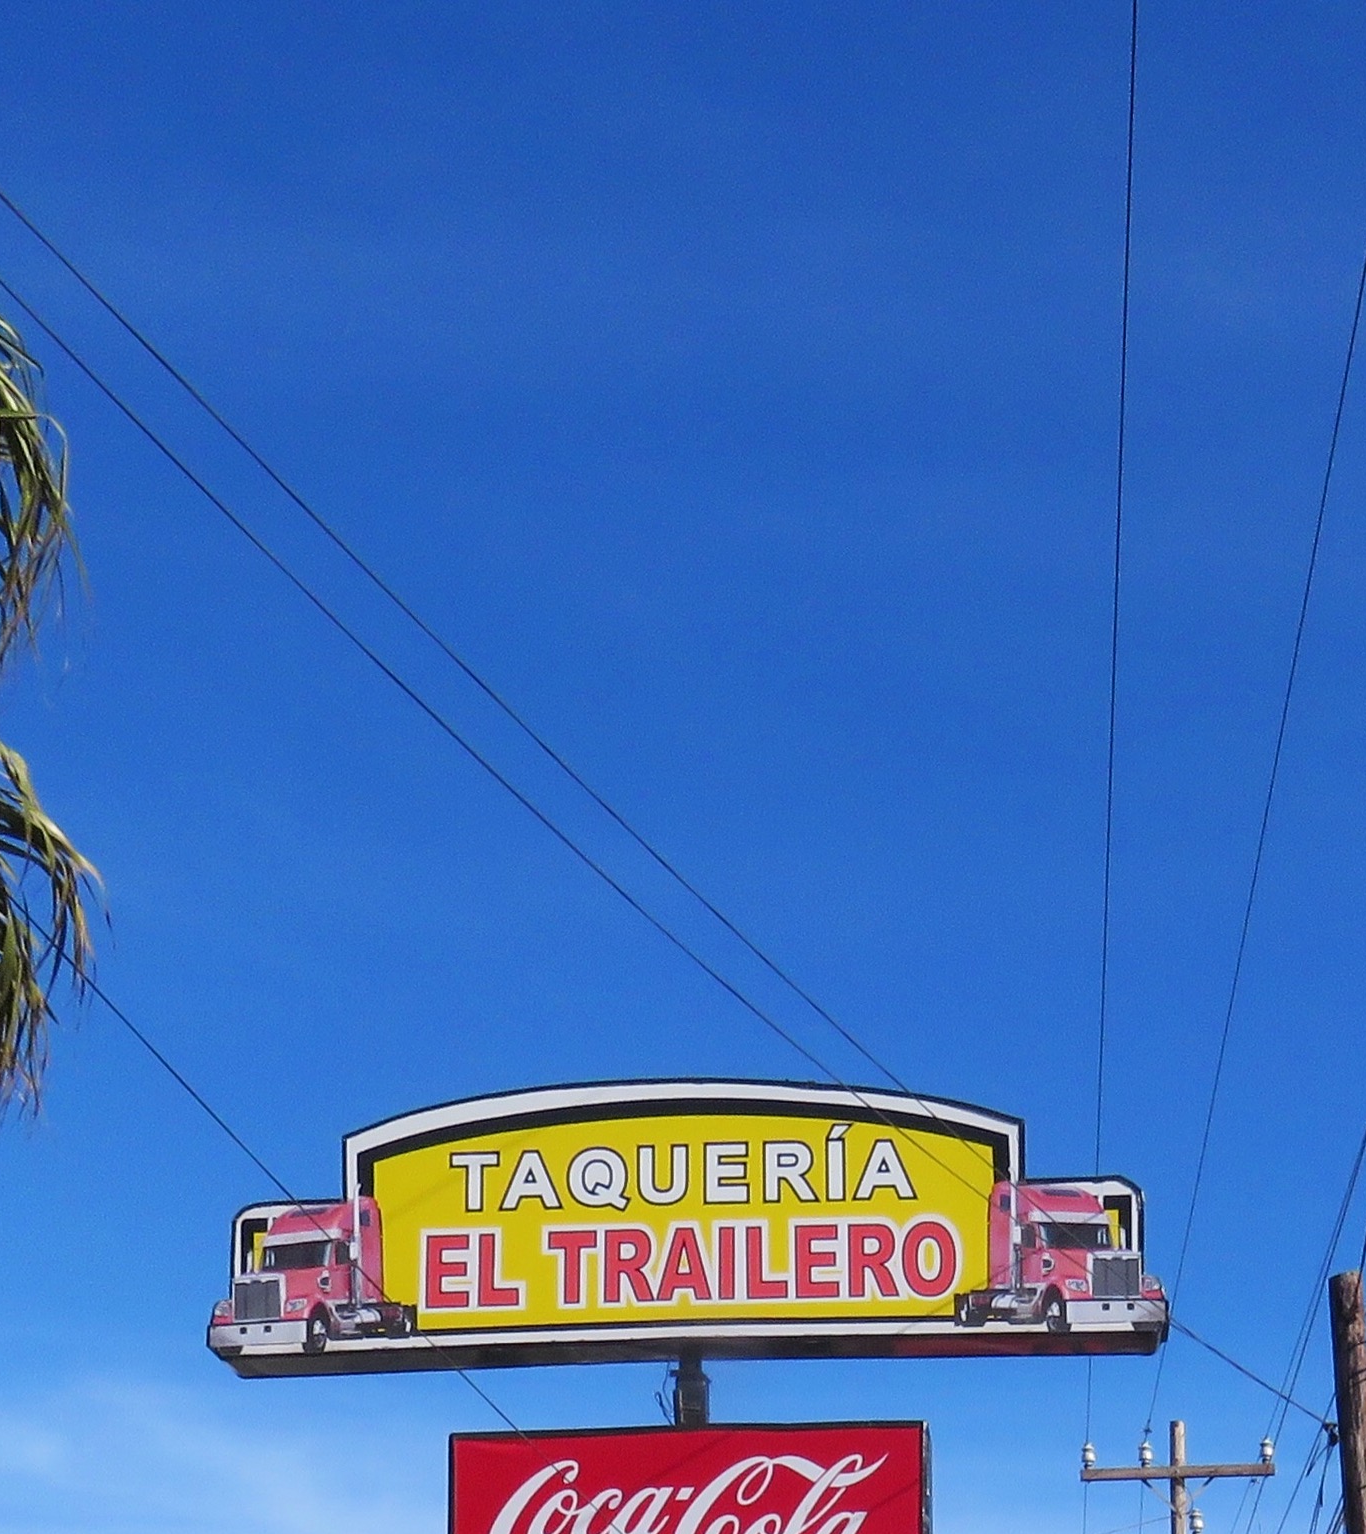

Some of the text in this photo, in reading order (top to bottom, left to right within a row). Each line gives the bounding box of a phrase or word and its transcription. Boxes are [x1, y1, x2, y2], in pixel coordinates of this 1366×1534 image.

[449, 1123, 918, 1212] TAQUERÍA
[422, 1218, 960, 1310] EL TRAILERO
